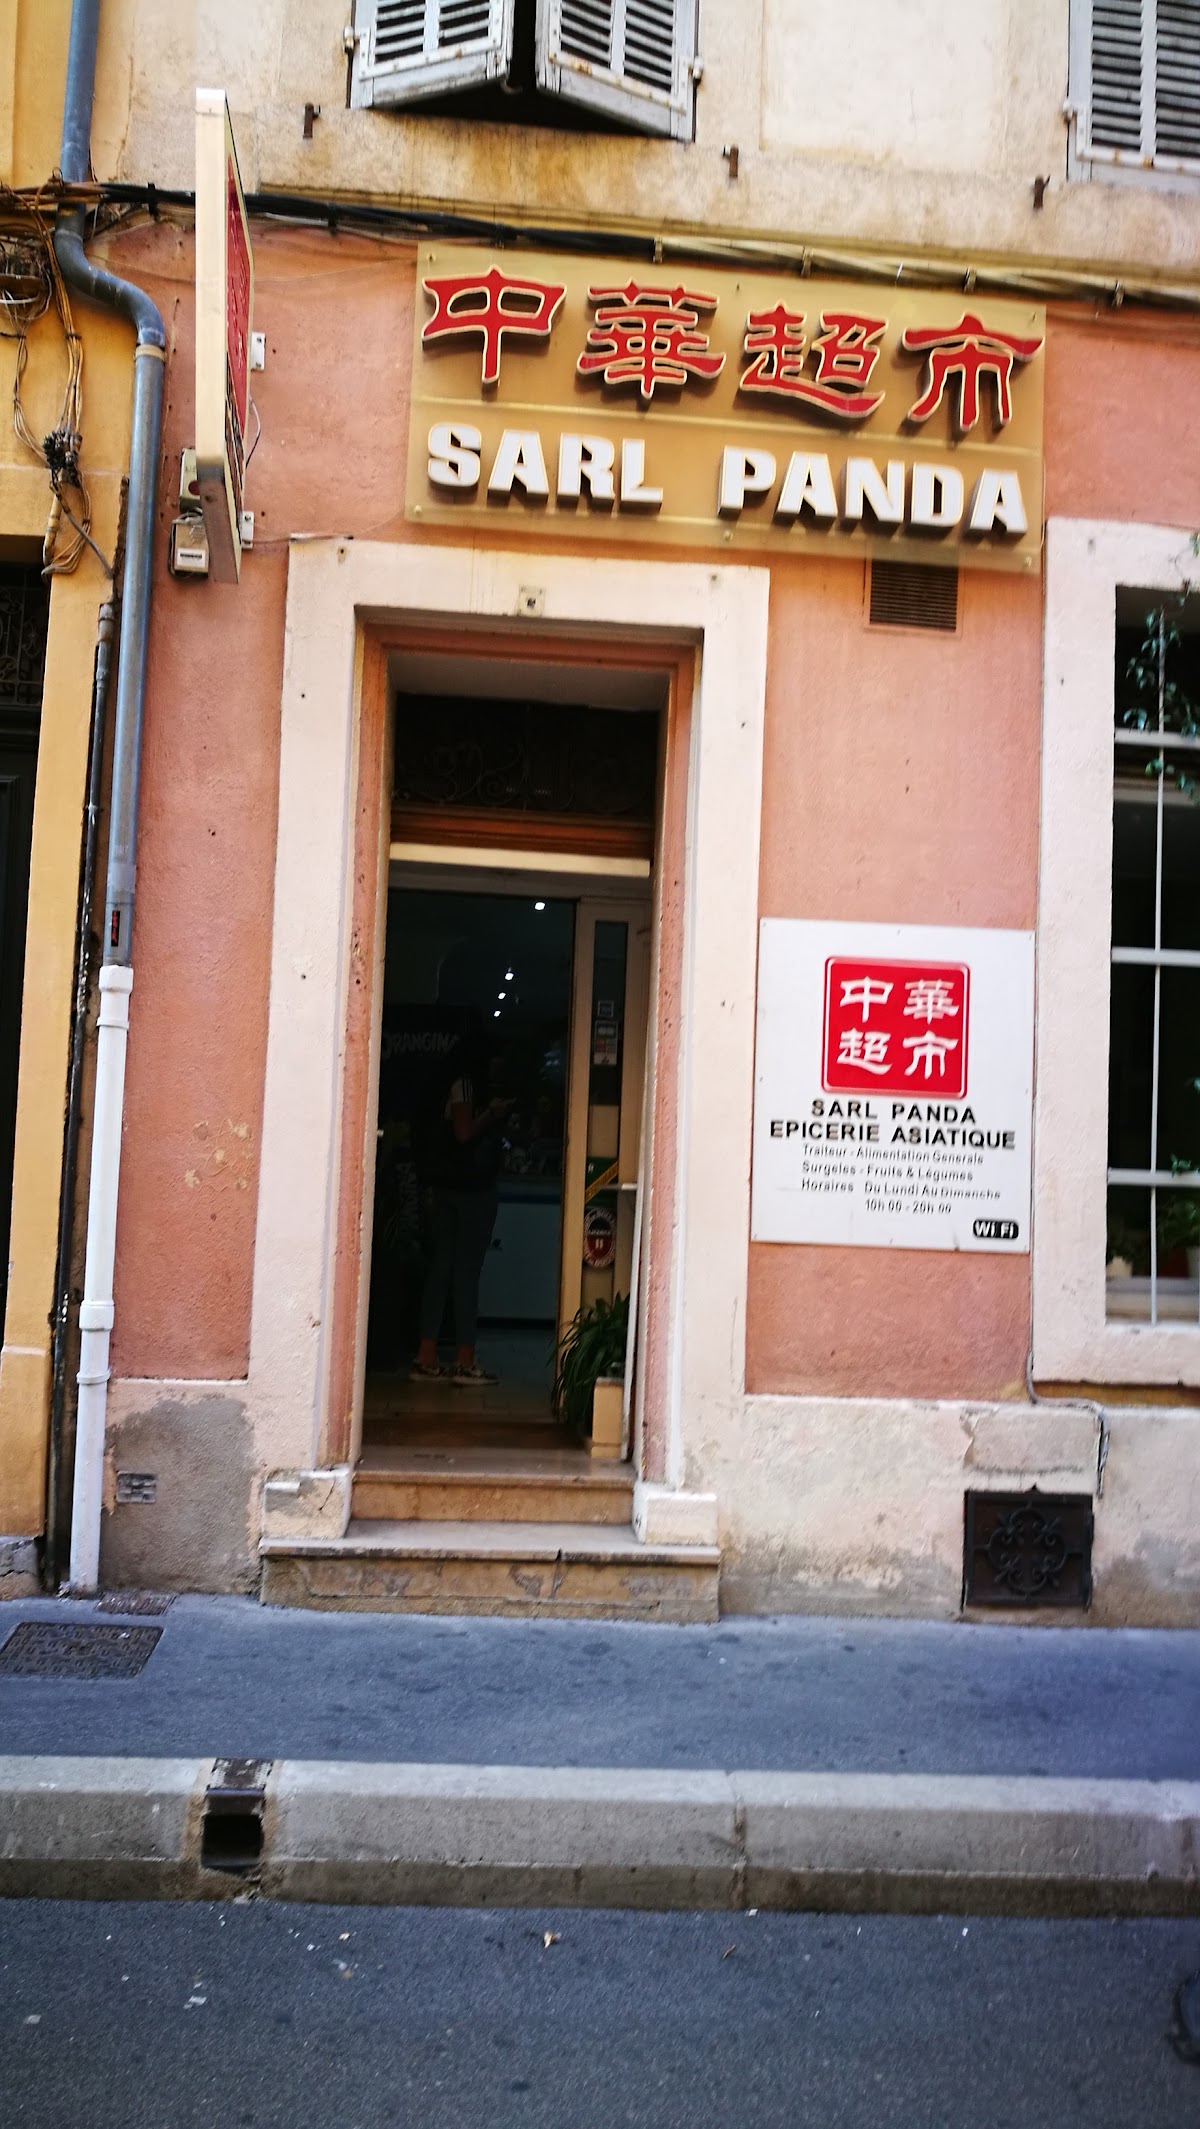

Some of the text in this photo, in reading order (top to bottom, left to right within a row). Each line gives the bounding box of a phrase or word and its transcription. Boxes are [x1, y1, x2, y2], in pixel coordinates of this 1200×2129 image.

[422, 266, 1045, 432] 中華超市
[427, 422, 1028, 535] SARL PANDA
[839, 976, 959, 1024] 中華
[837, 1028, 959, 1080] 超市
[811, 1099, 977, 1125] SARL PANDA
[769, 1120, 1016, 1150] EPICERIE ASIATIQUE
[803, 1142, 847, 1157] Traiteur
[856, 1145, 930, 1162] Alimentation
[867, 1163, 903, 1177] Fruits
[906, 1165, 914, 1178] &
[801, 1177, 1001, 1200] Horaires Du Lundi Au Dimanche
[865, 1198, 885, 1213] 10h
[912, 1200, 934, 1214] 20h
